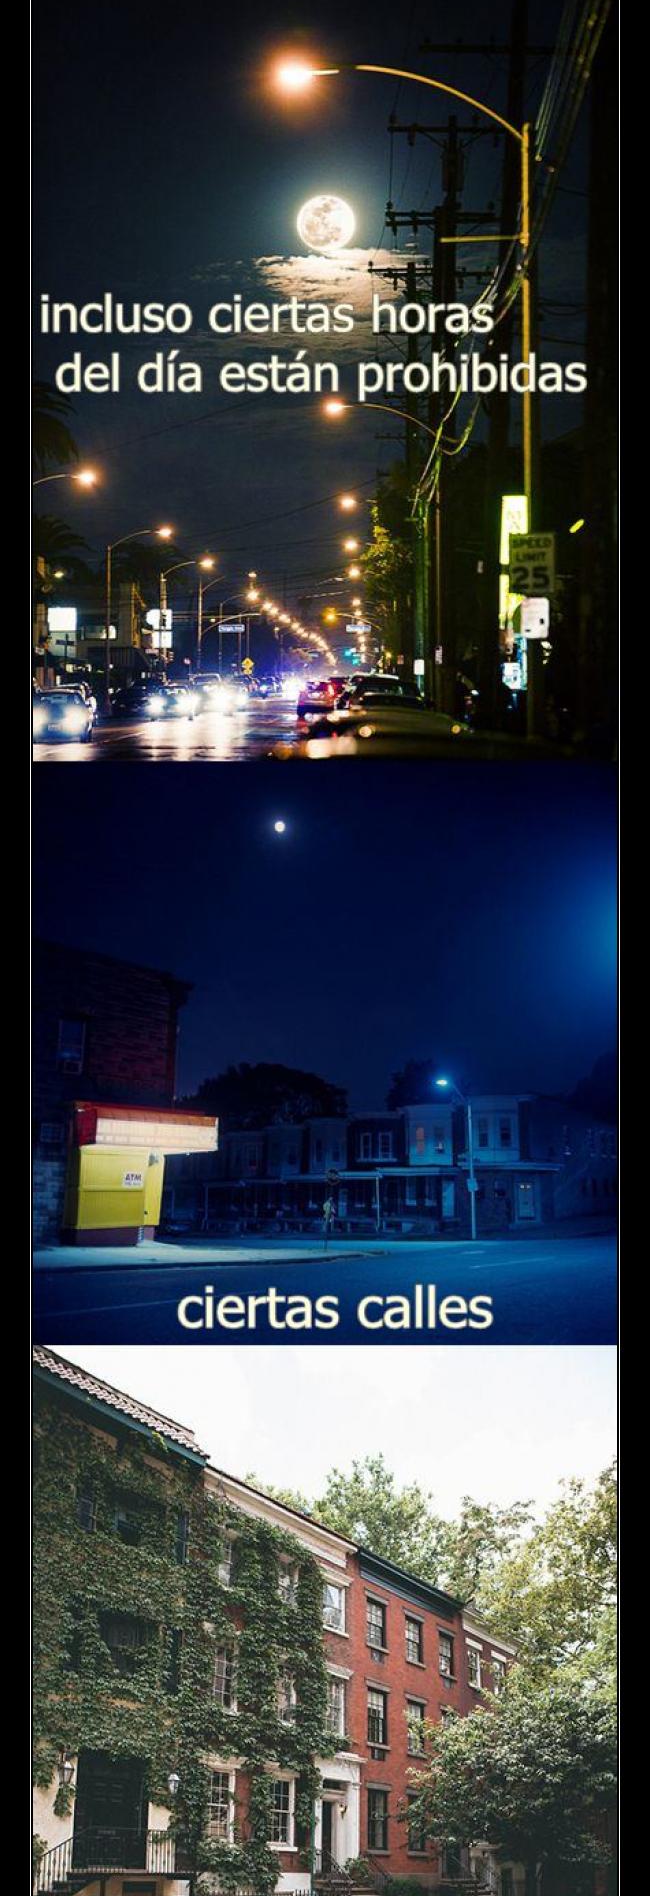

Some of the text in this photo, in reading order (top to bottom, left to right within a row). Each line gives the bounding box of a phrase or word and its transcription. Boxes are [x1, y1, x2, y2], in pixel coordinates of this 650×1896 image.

[511, 536, 552, 549] SPEED
[511, 566, 550, 590] 25
[125, 1173, 142, 1182] ATM
